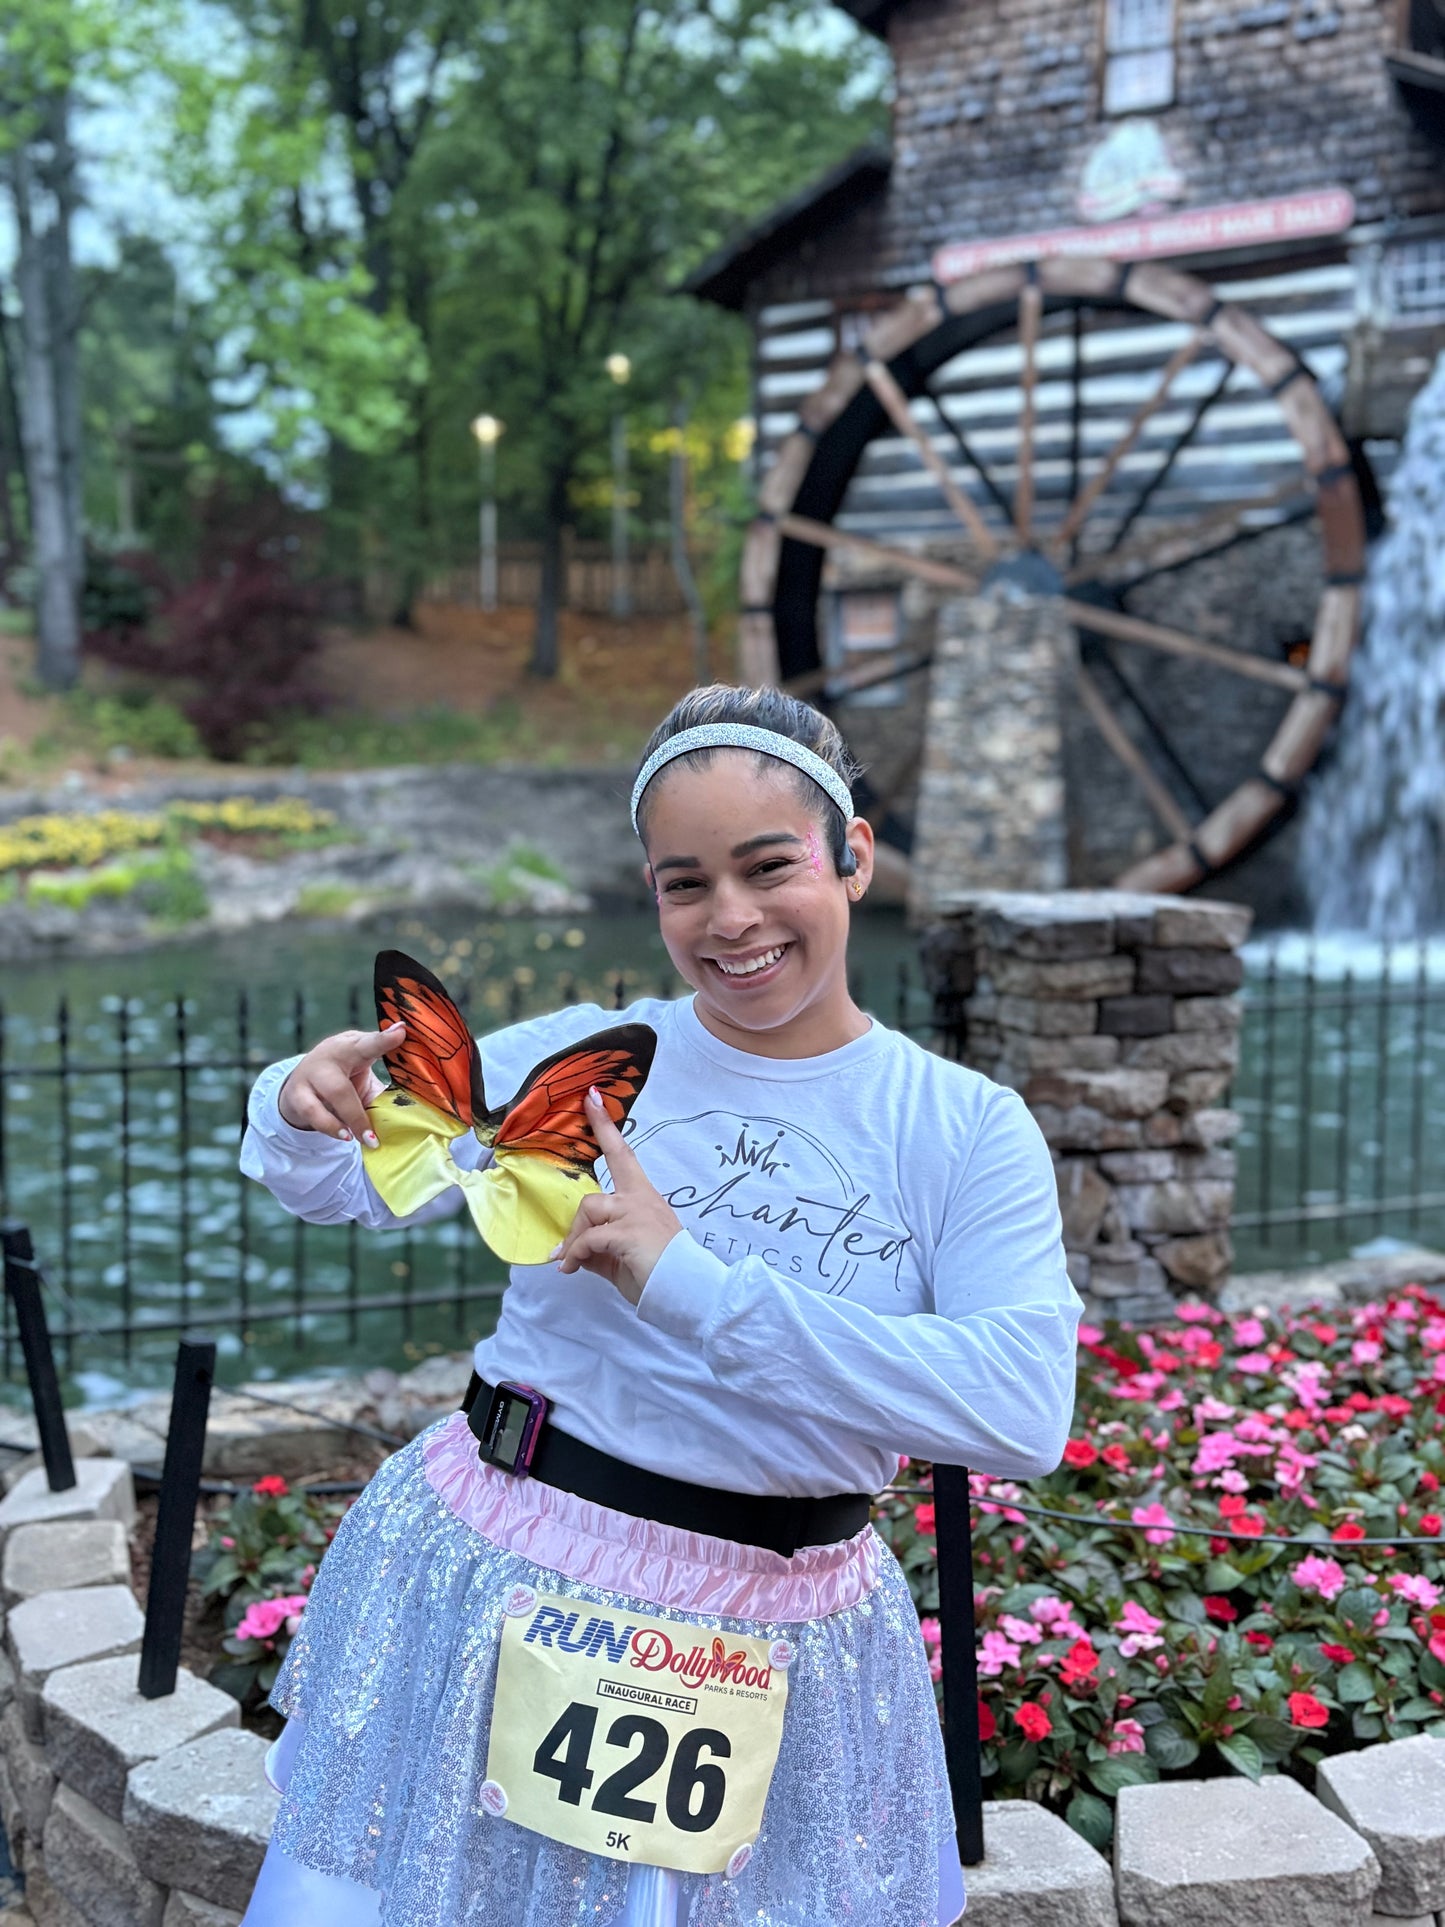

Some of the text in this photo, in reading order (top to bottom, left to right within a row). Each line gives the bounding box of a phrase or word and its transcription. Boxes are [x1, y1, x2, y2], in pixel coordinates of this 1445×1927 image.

[694, 1229, 803, 1273] ETICS
[523, 1605, 637, 1664] RUN
[603, 1683, 691, 1711] INAUGURAL RACE
[704, 1683, 768, 1702] PARKS & RESORTS
[532, 1701, 732, 1833] 426
[605, 1831, 631, 1851] 5K
